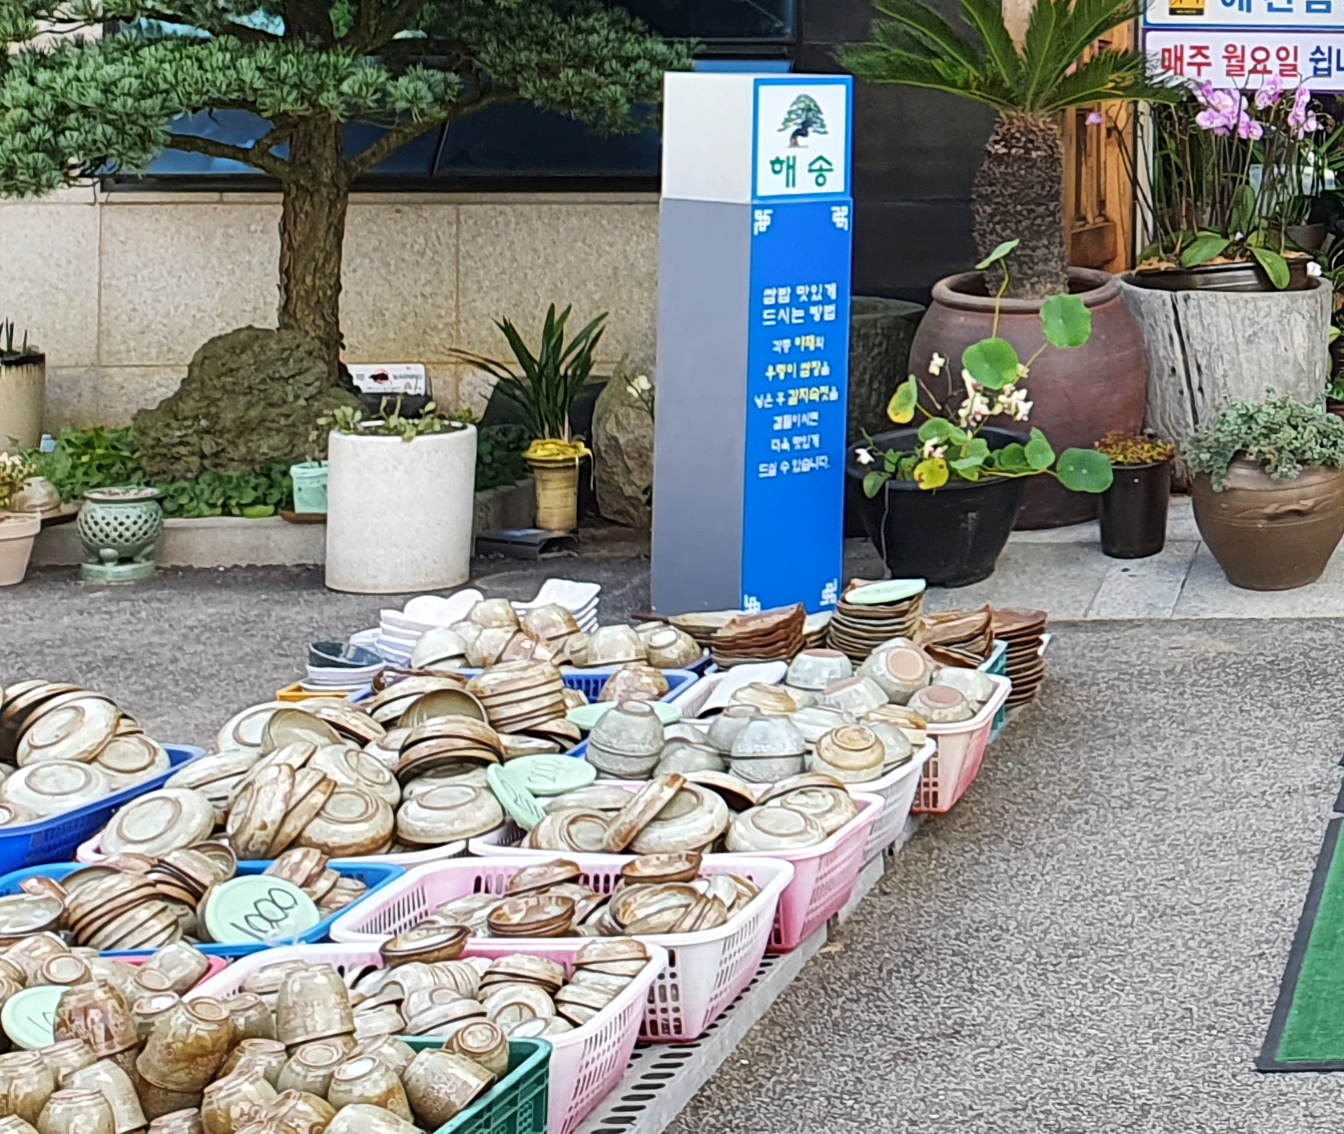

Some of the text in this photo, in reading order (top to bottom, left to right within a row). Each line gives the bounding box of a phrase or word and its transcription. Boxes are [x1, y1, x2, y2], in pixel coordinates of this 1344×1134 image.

[1161, 44, 1213, 76] 매주
[1221, 44, 1299, 78] 월요일
[770, 154, 834, 189] 해송
[763, 282, 836, 305] 쌈밥 맛있게
[762, 303, 836, 326] 드시는 방법
[780, 460, 790, 475] 수
